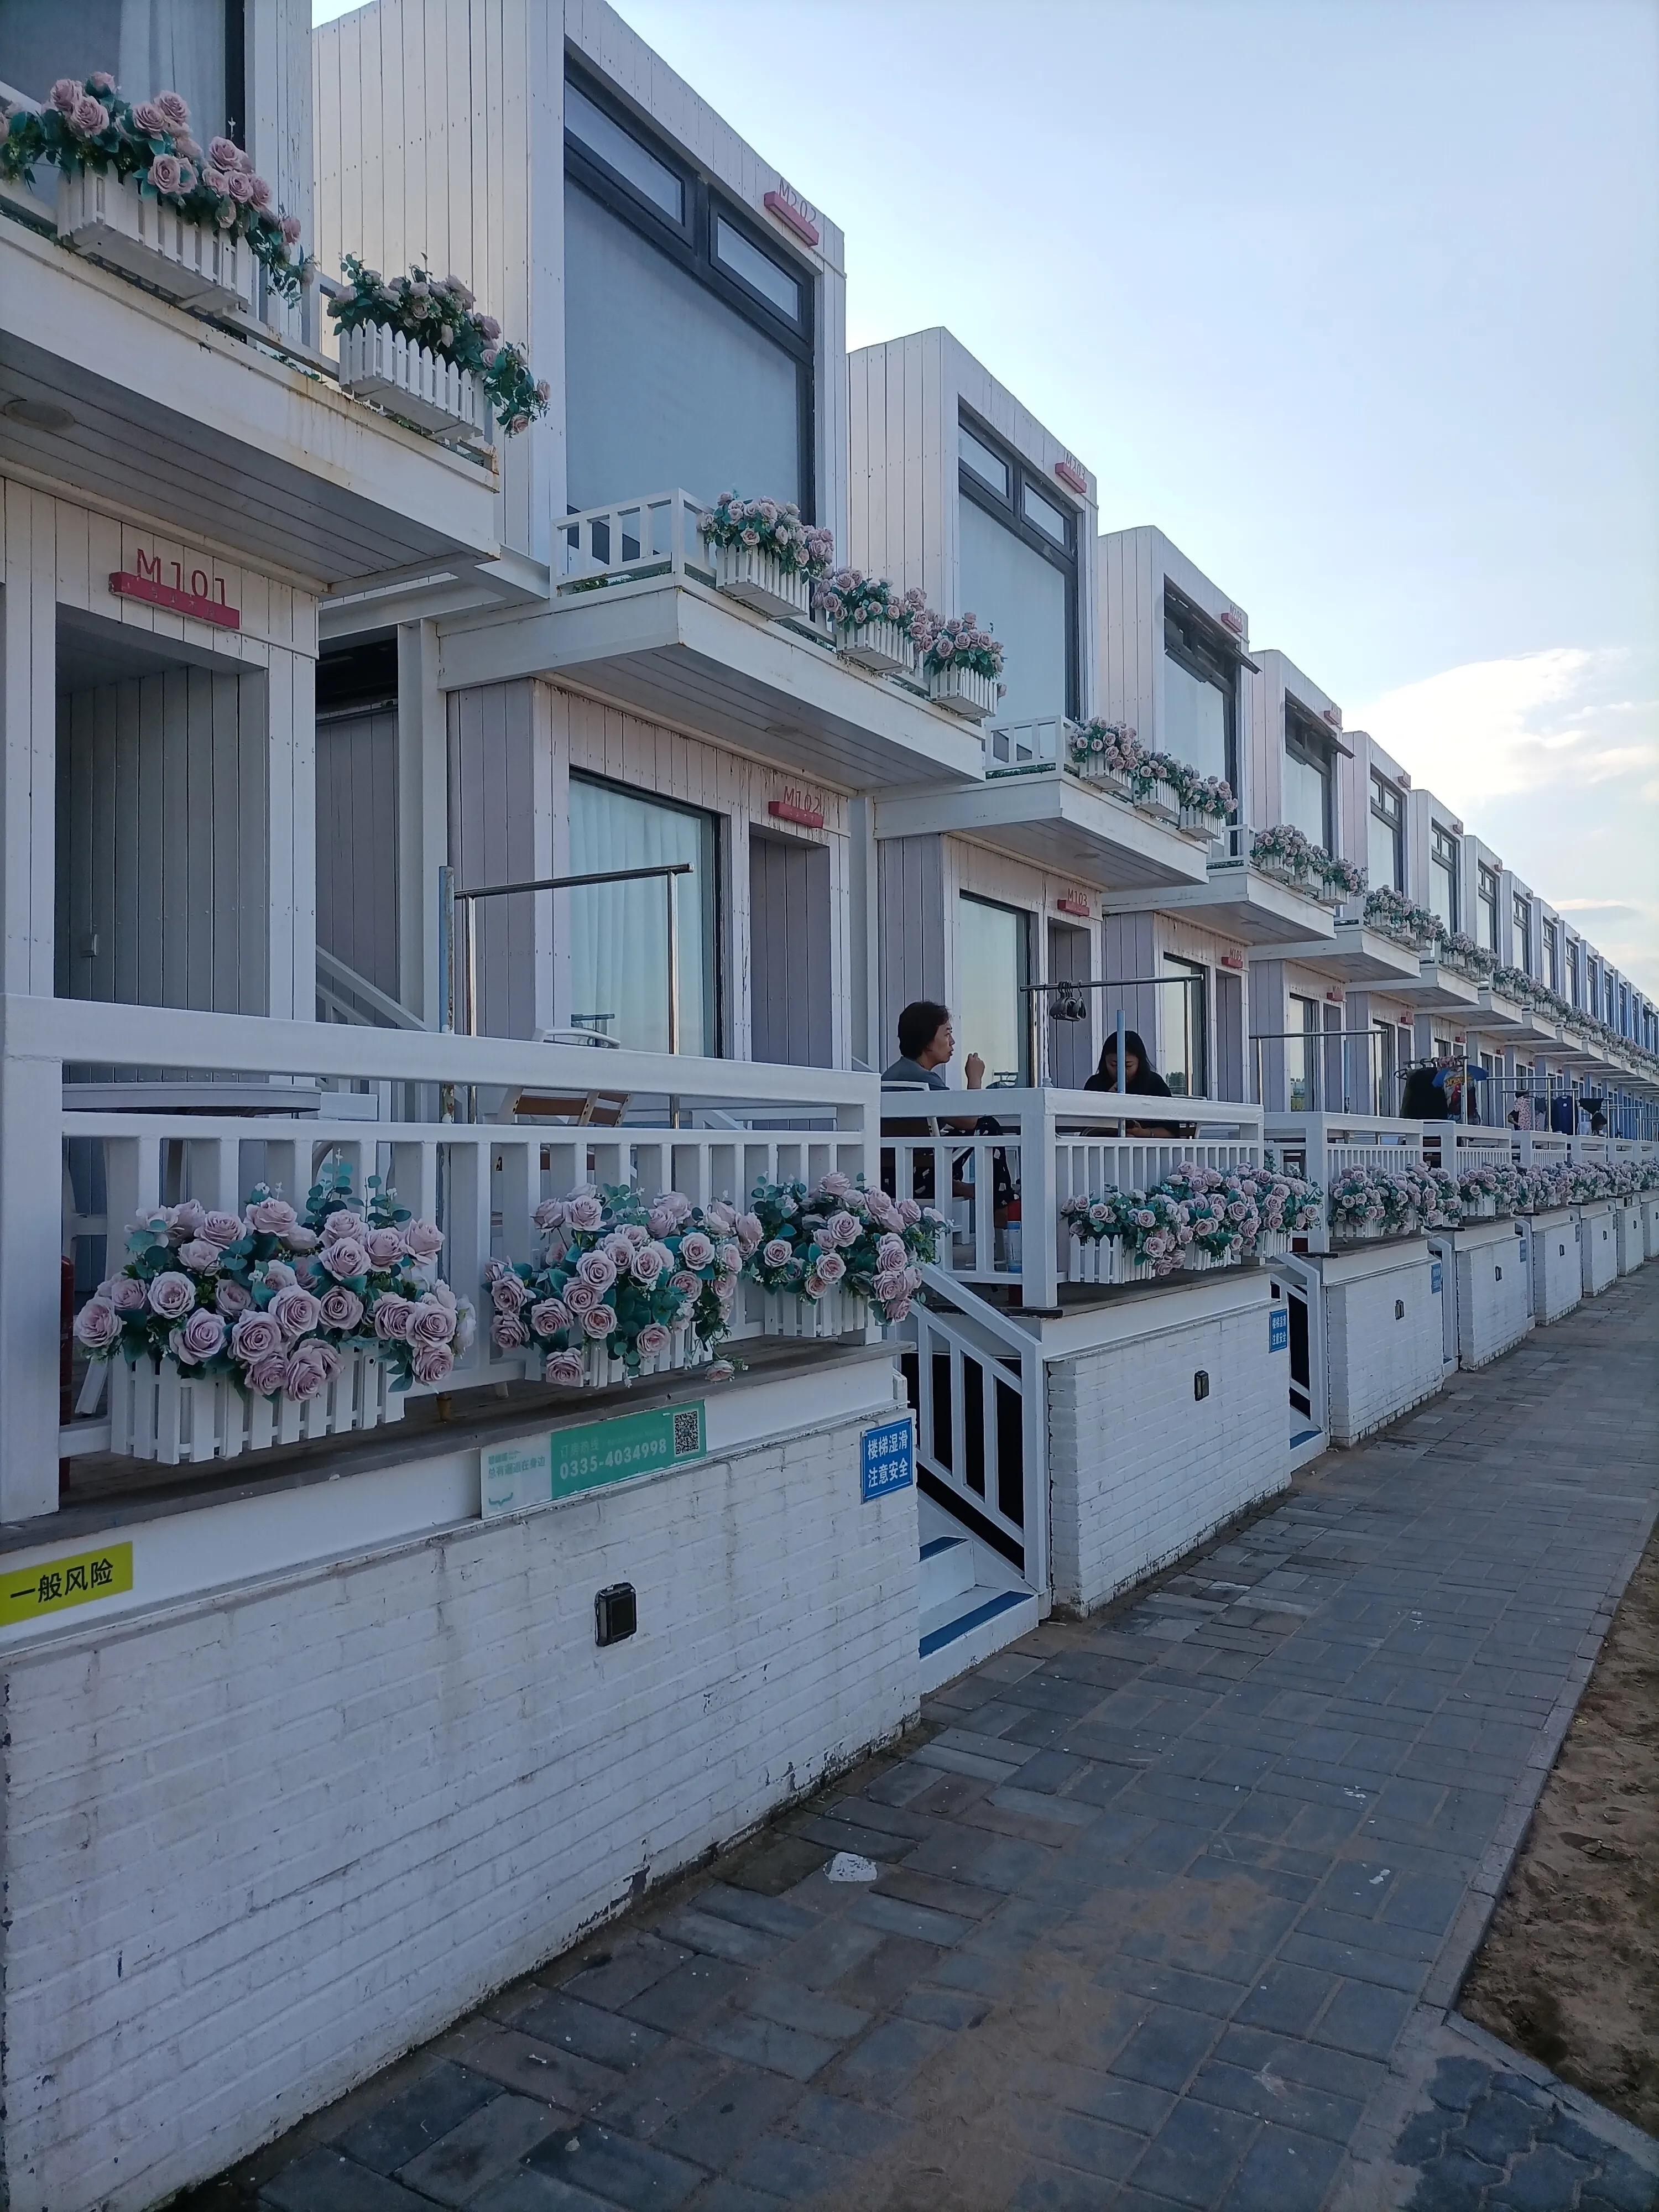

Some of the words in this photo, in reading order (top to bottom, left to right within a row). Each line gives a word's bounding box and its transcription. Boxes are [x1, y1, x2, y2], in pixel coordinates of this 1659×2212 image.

[137, 549, 226, 607] M101
[784, 786, 821, 813] M102
[1067, 888, 1087, 907] M103
[560, 1438, 667, 1480] 0335-4034998
[868, 1430, 908, 1460] 楼梯湿滑
[868, 1457, 908, 1488] 注意安全
[10, 1558, 113, 1603] 一般风险
